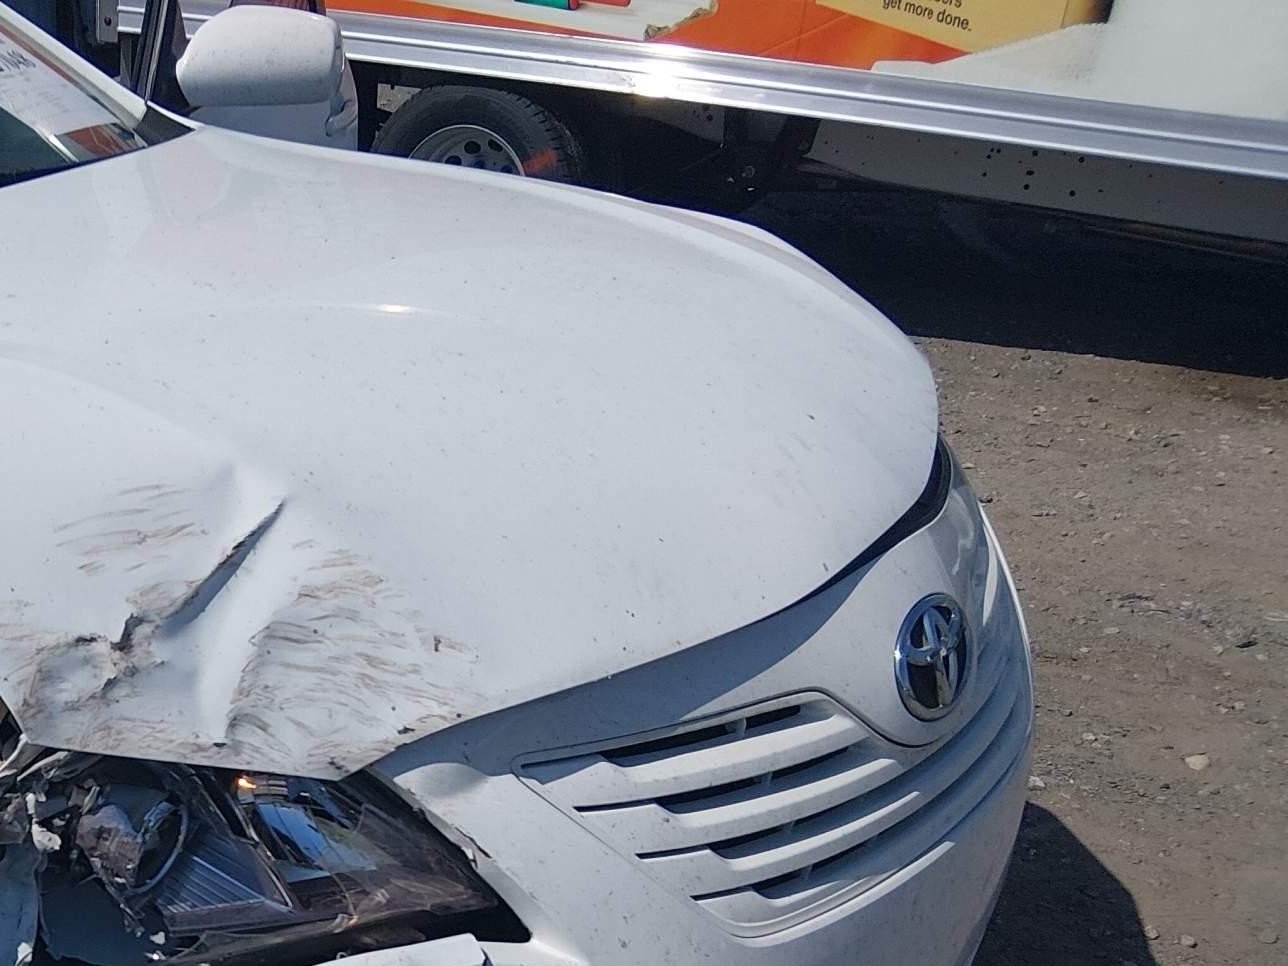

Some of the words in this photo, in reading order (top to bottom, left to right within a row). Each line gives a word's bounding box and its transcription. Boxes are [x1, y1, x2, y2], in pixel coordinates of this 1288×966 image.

[882, 0, 902, 10] get
[904, 1, 934, 19] more
[936, 9, 972, 32] done.
